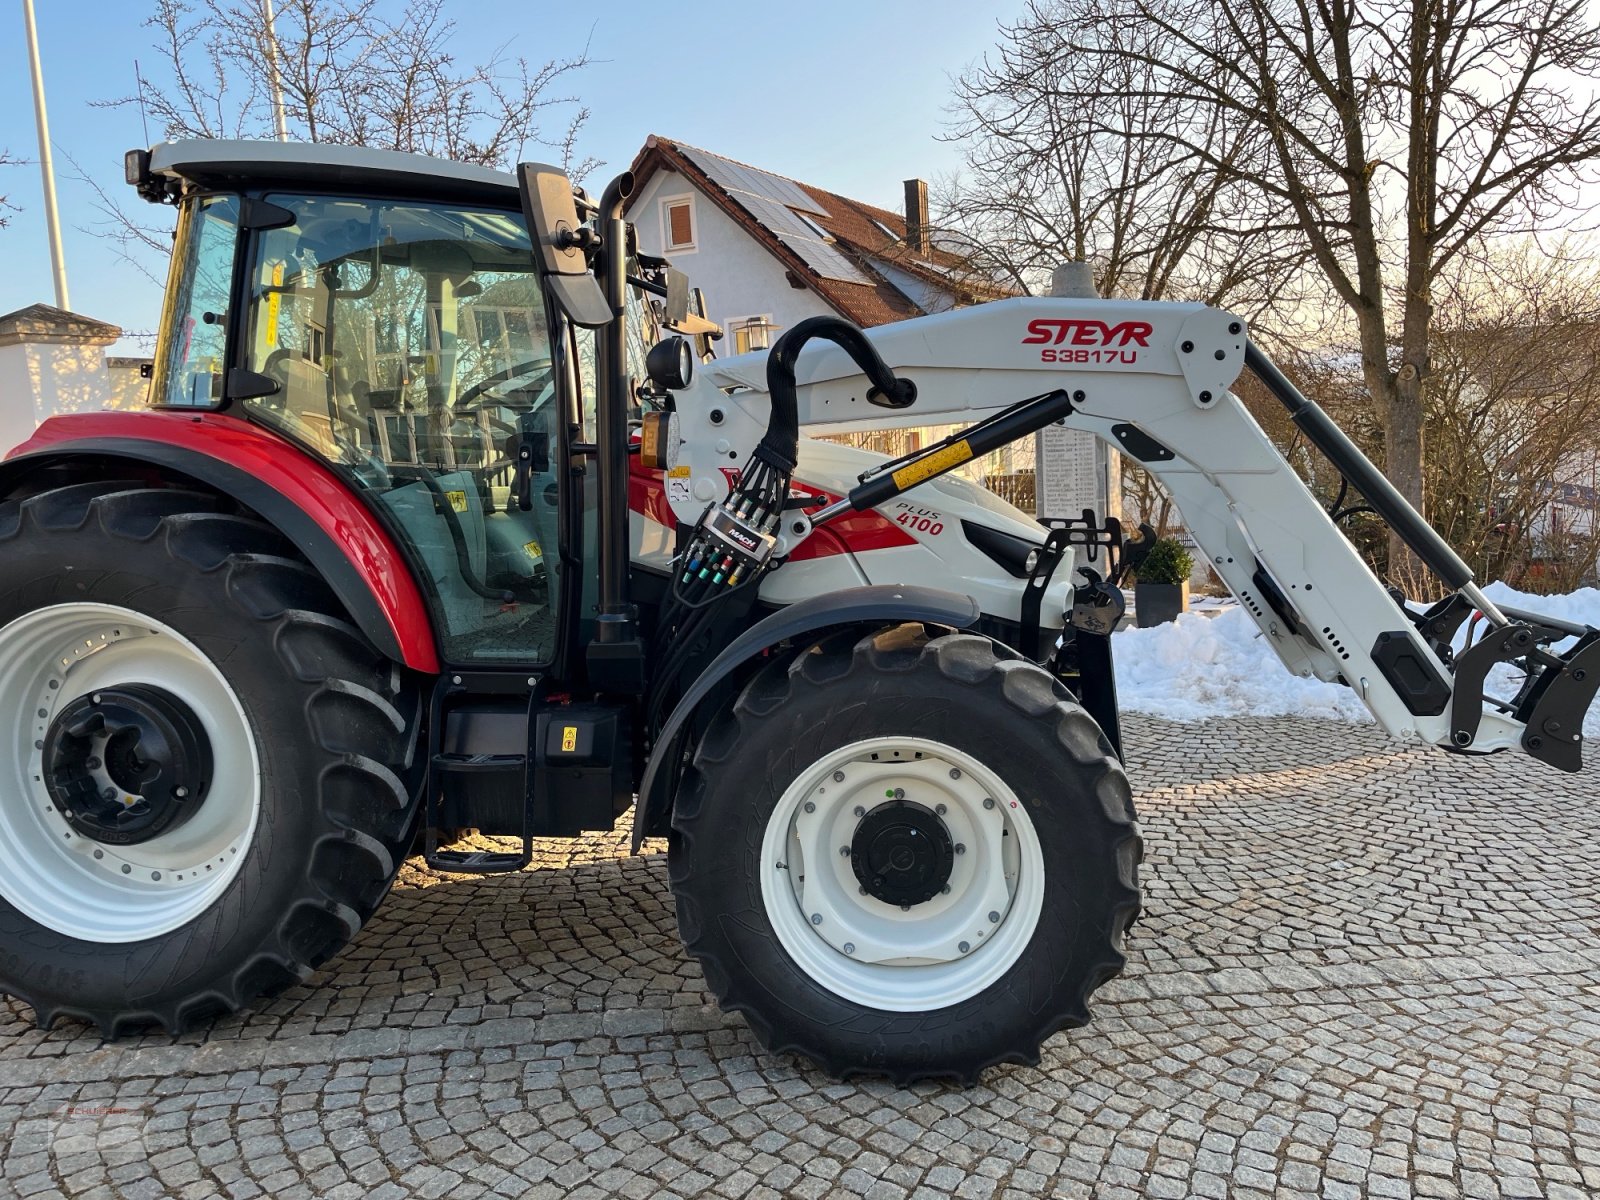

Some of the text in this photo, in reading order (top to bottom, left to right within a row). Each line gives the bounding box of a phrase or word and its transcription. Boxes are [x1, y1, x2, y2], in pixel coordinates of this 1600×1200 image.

[1021, 319, 1153, 347] STEYR
[1041, 349, 1137, 364] S3817U
[896, 502, 941, 519] PLUS
[896, 512, 944, 535] 4100
[728, 528, 757, 547] MACH
